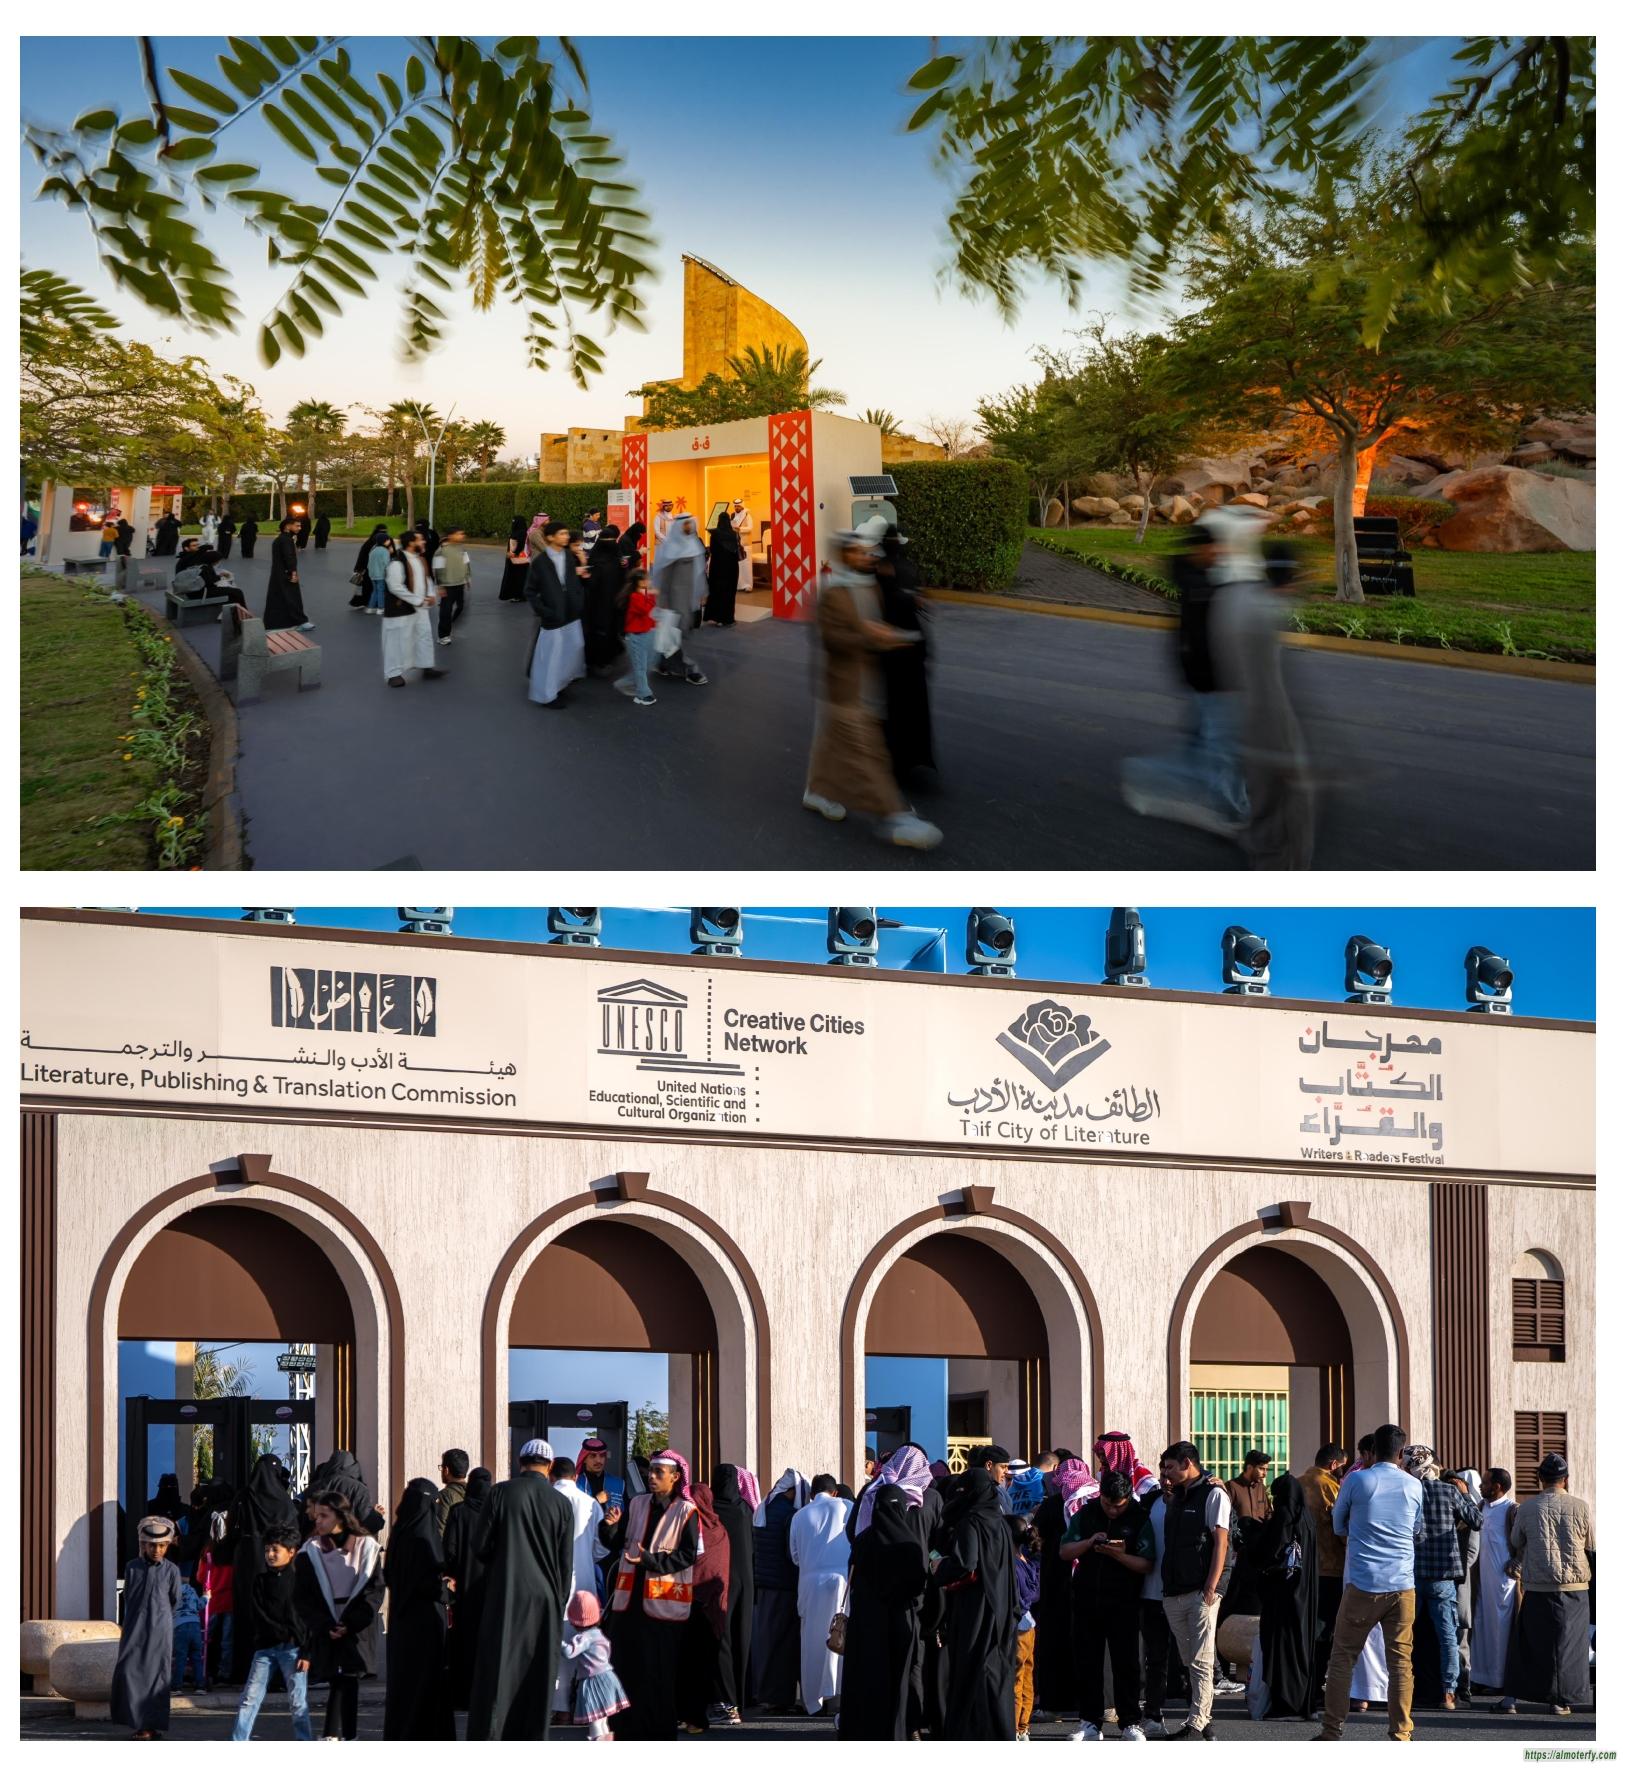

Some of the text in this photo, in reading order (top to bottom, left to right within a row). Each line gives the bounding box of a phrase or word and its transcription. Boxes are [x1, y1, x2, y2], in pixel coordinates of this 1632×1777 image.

[602, 1004, 683, 1052] UNESCO
[724, 1008, 865, 1035] Creative Cities
[20, 1030, 517, 1080] هيئة الأدب والنشر والترجمة
[724, 1032, 808, 1055] Network
[1298, 1020, 1442, 1063] مهرجان
[21, 1062, 517, 1106] Literature, Publishing & Translation Commission
[657, 1080, 697, 1094] United
[589, 1090, 747, 1110] Educational, Scientific and
[617, 1106, 665, 1120] Cultural
[1020, 1084, 1084, 1122] مدينة
[1085, 1085, 1161, 1123] الطائف
[997, 1121, 1034, 1143] City
[1039, 1123, 1058, 1141] of
[1300, 1147, 1343, 1160] Writers
[1402, 1152, 1444, 1165] Festival
